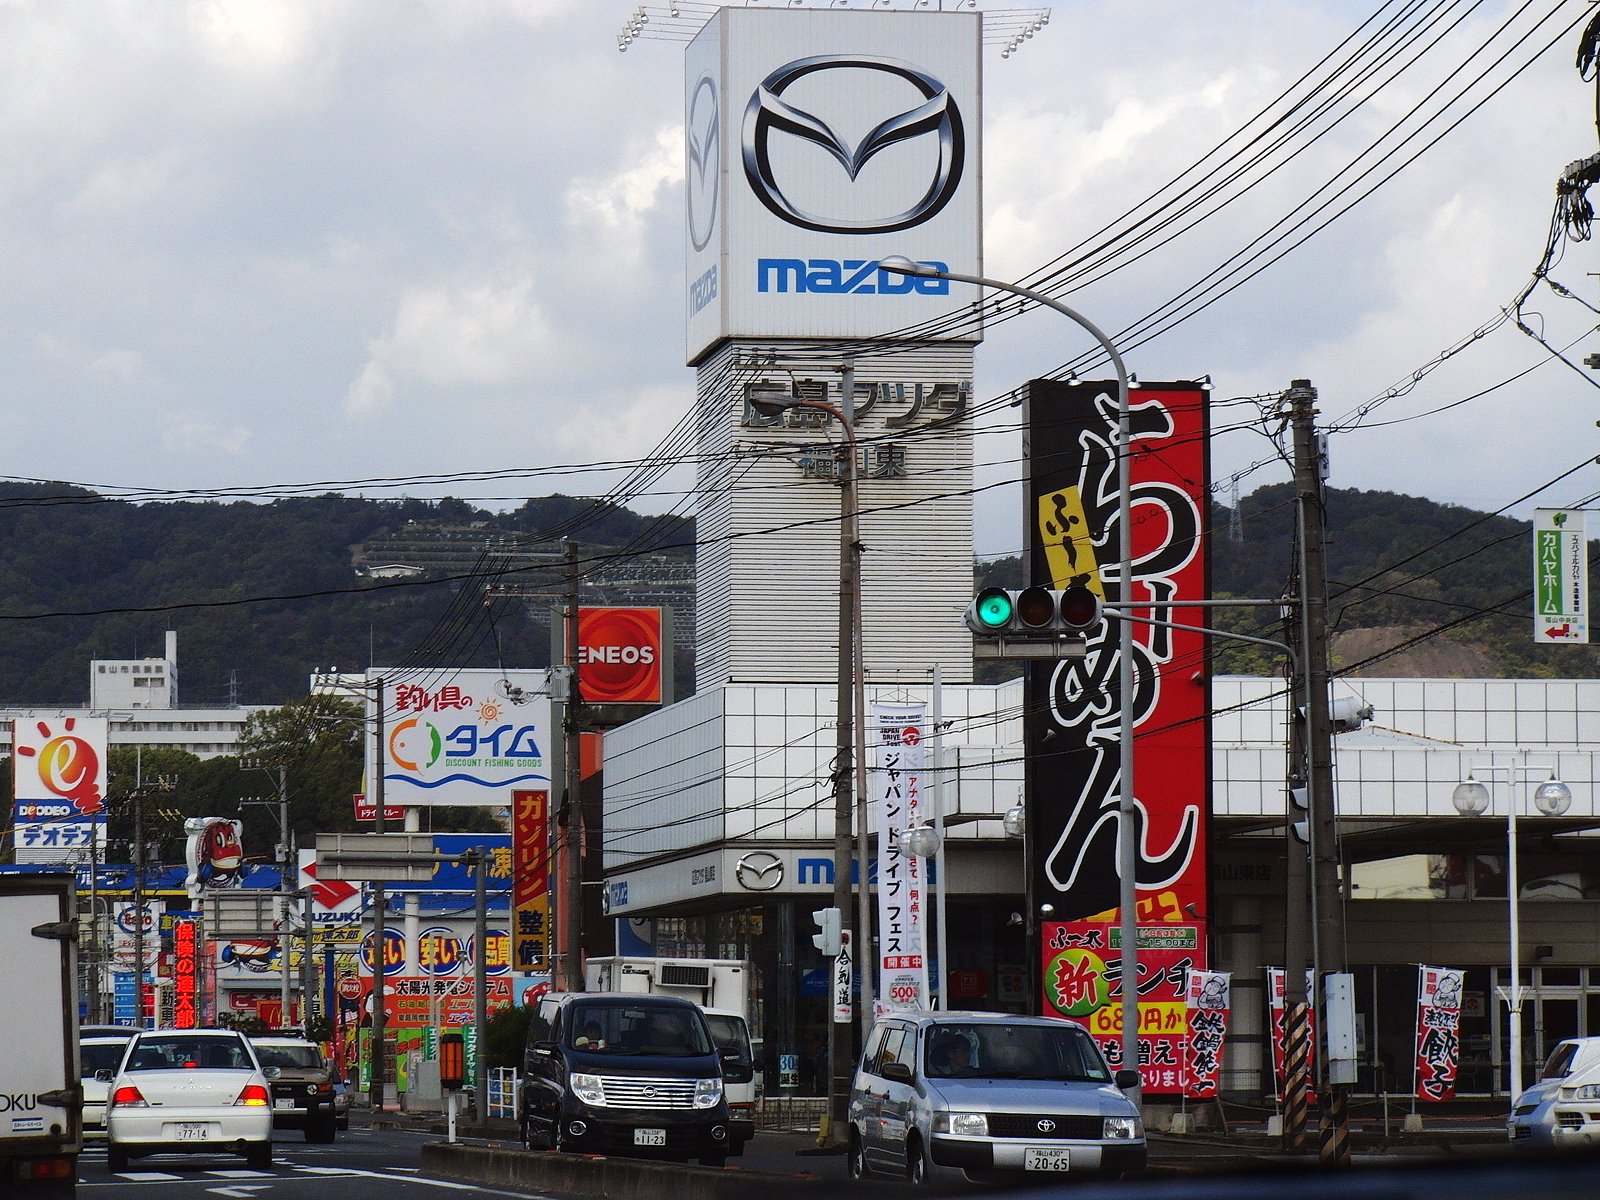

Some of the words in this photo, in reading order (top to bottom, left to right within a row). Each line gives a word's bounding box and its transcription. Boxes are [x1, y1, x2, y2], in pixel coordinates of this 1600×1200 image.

[741, 378, 973, 427] 広島マツダ
[1542, 533, 1558, 613] カバヤホーム
[578, 646, 654, 664] ENEOS
[396, 684, 473, 712] 釣り具の
[446, 724, 541, 758] タイム
[446, 759, 481, 768] DISCOUNT
[484, 759, 514, 768] FISHING
[517, 759, 542, 768] GOODS
[361, 809, 399, 818] ドライスルー
[518, 795, 544, 897] ガソリン
[518, 909, 544, 966] 整備
[887, 957, 922, 968] 開催中
[342, 984, 360, 993] 消火栓
[1053, 954, 1098, 1009] 新
[183, 1129, 207, 1139] 77-14
[642, 1135, 664, 1145] 11-23
[1034, 1157, 1068, 1170] 20-65
